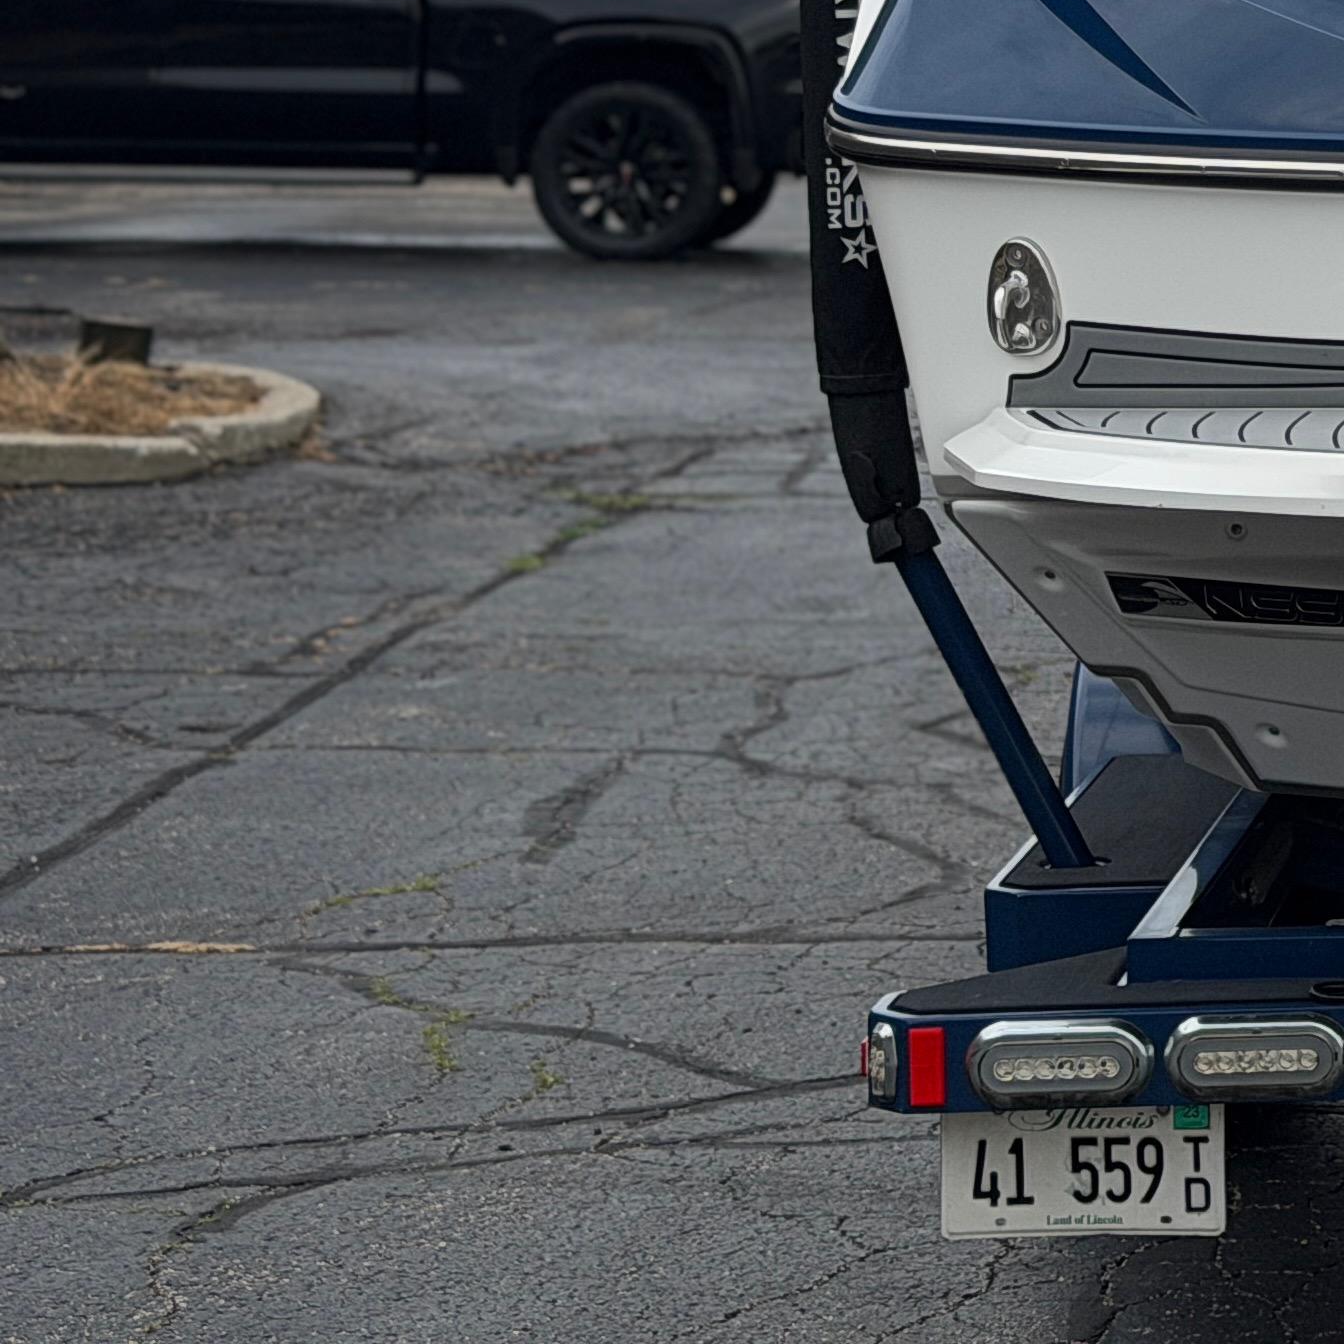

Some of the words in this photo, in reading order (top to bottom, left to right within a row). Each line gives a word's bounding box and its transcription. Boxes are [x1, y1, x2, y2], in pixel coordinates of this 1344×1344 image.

[825, 157, 843, 229] .COM
[1008, 1106, 1159, 1130] Illinois
[972, 1137, 1034, 1207] 41
[1071, 1137, 1164, 1204] 559
